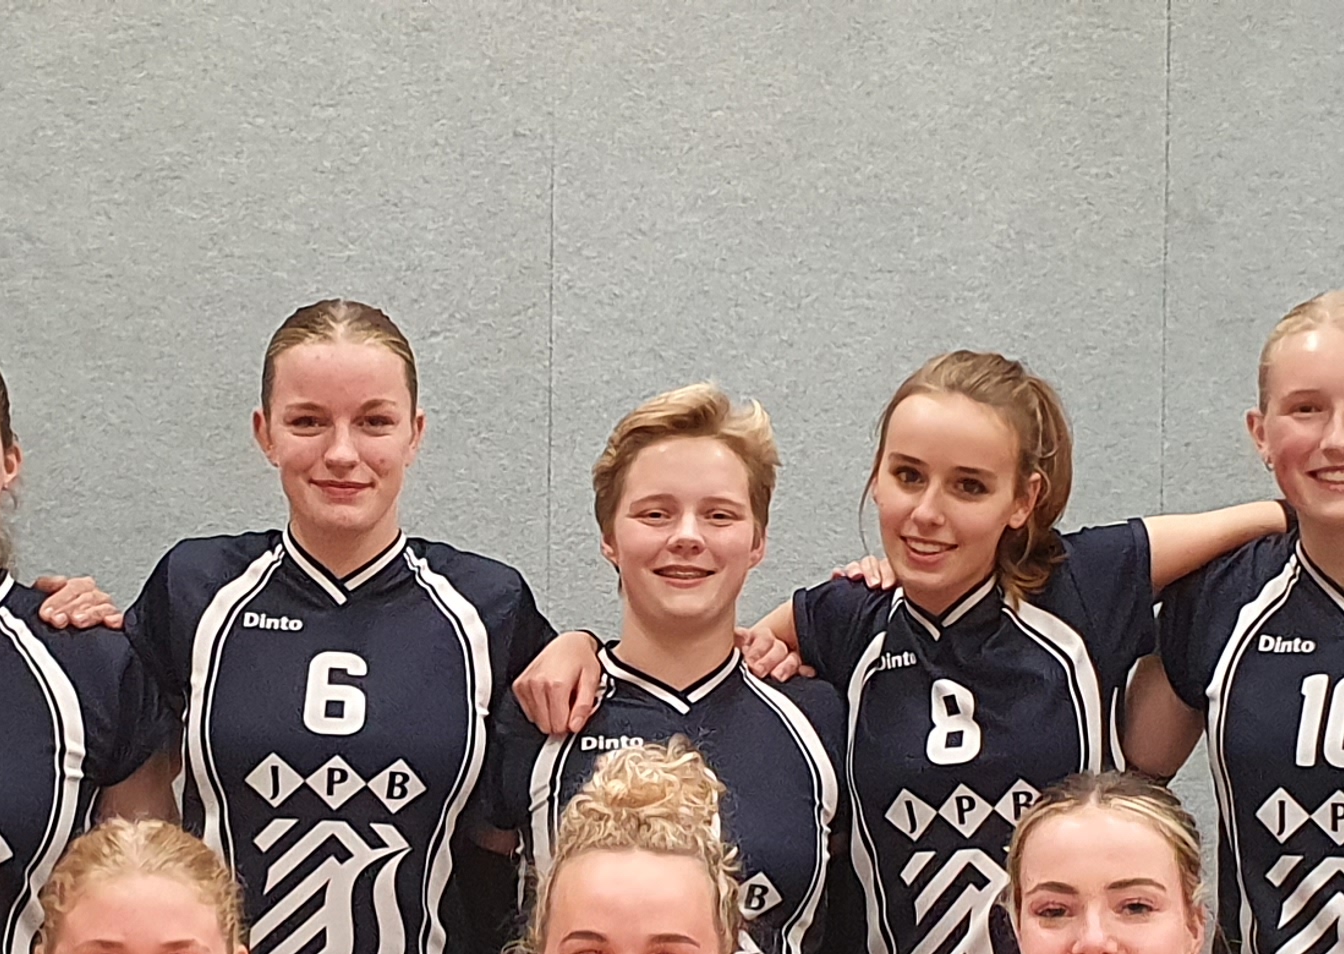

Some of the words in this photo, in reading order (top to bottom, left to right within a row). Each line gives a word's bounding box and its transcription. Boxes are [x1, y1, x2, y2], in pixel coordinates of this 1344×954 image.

[242, 612, 303, 632] Dinto
[1258, 634, 1316, 654] Dinto
[303, 651, 368, 735] 6
[926, 678, 981, 765] 8
